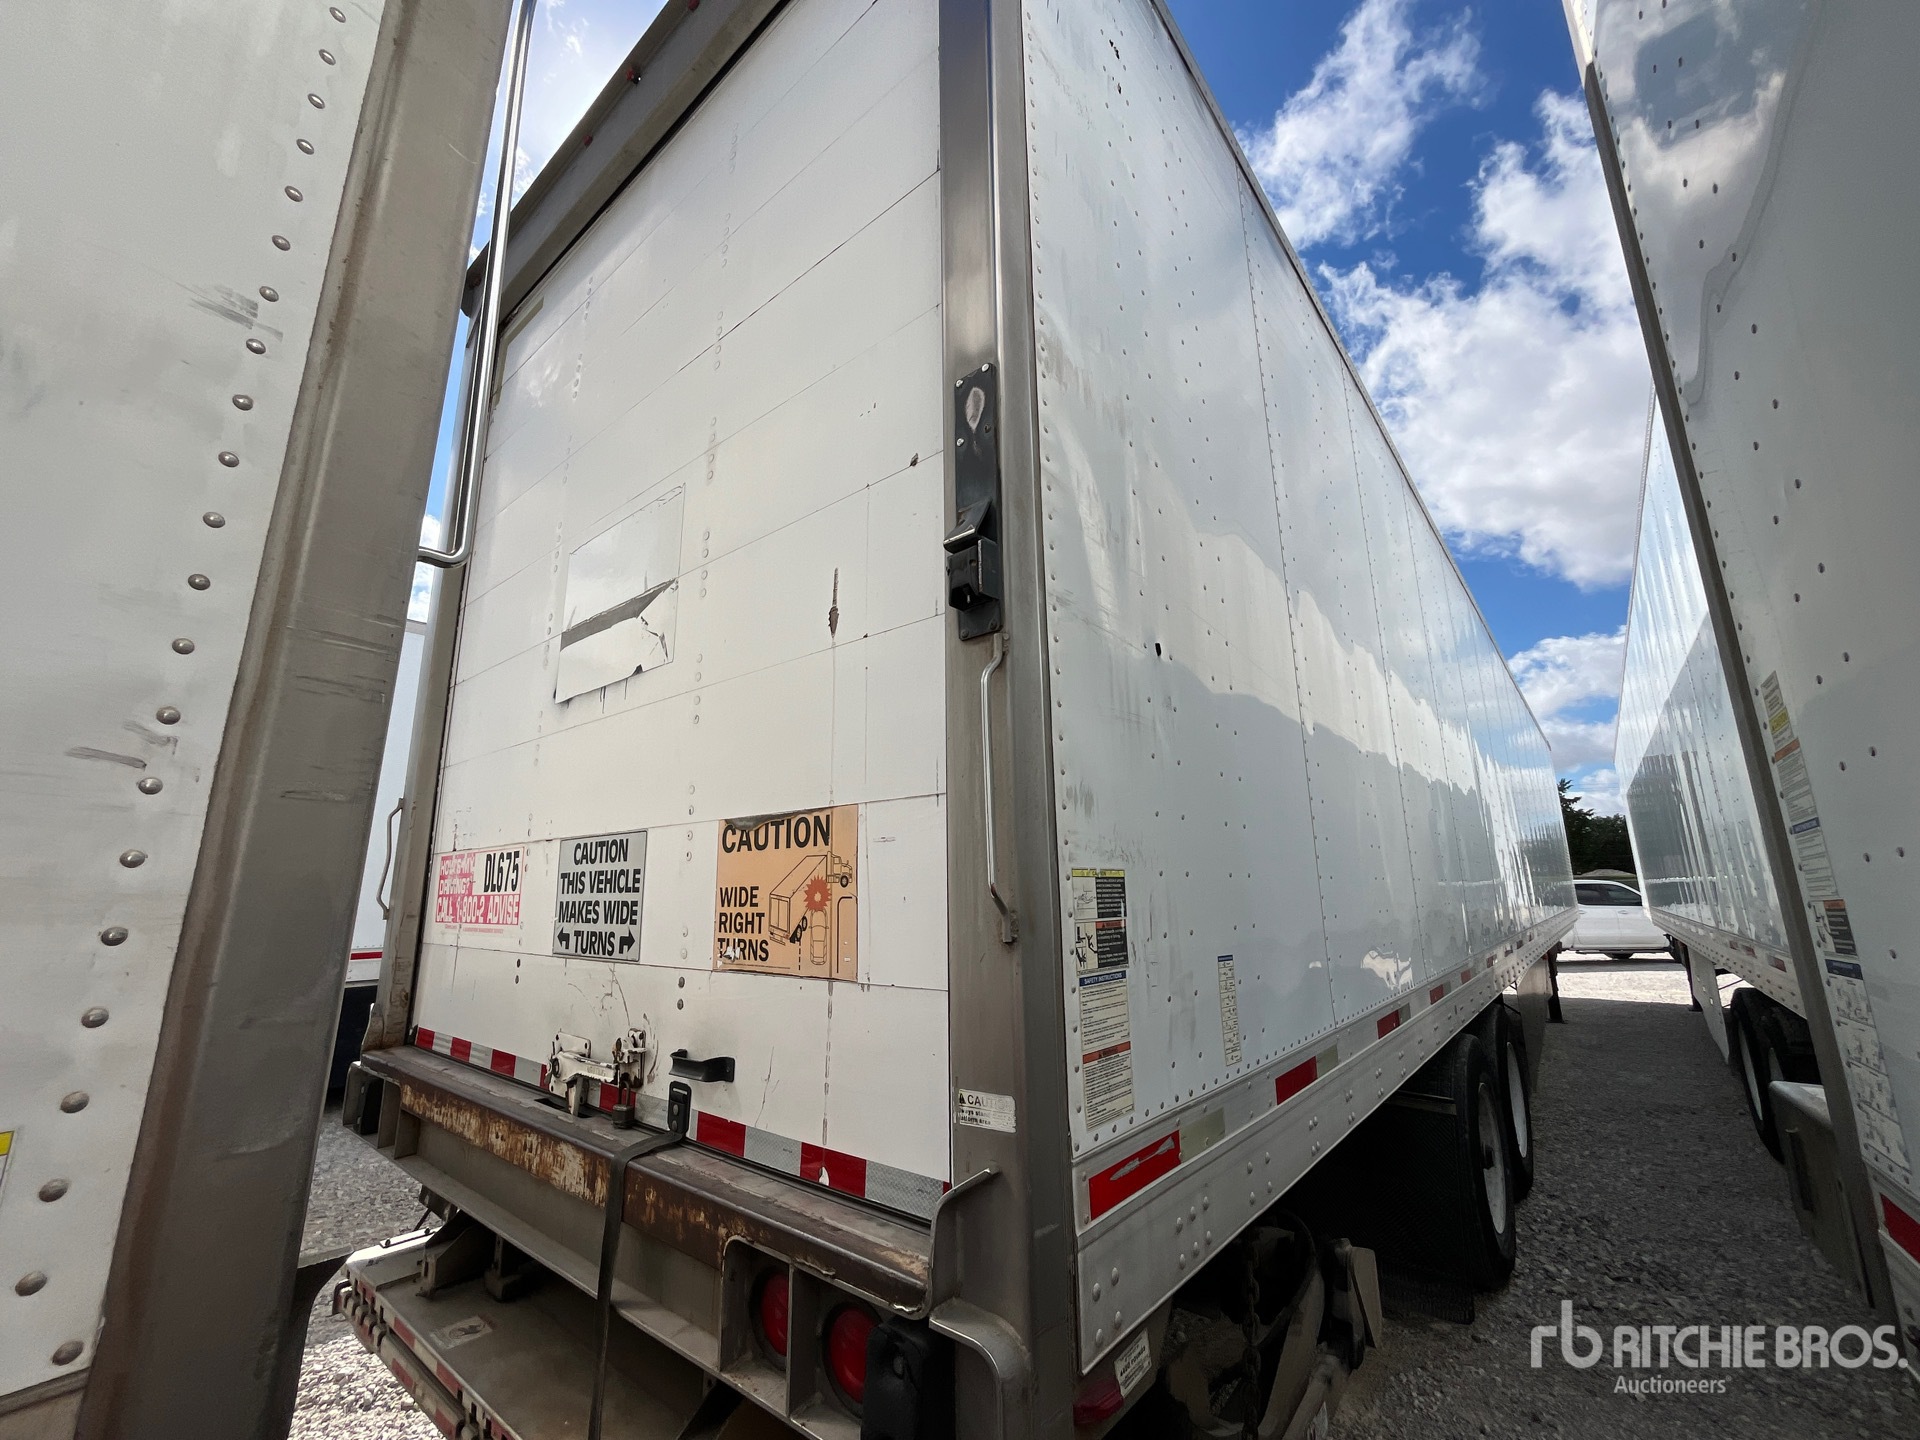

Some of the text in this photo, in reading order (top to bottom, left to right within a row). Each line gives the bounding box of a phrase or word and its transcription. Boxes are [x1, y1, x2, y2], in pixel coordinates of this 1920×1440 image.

[722, 814, 831, 853] CAUTION
[574, 838, 629, 865] CAUTION
[484, 851, 520, 893] DL675
[561, 869, 641, 894] THIS VEHICLE
[436, 897, 454, 923] CALL
[487, 895, 519, 925] ADVISE
[720, 886, 759, 908] WIDE
[558, 900, 638, 925] MAKES WIDE
[718, 912, 765, 935] RIGHT
[574, 930, 615, 956] TURNS
